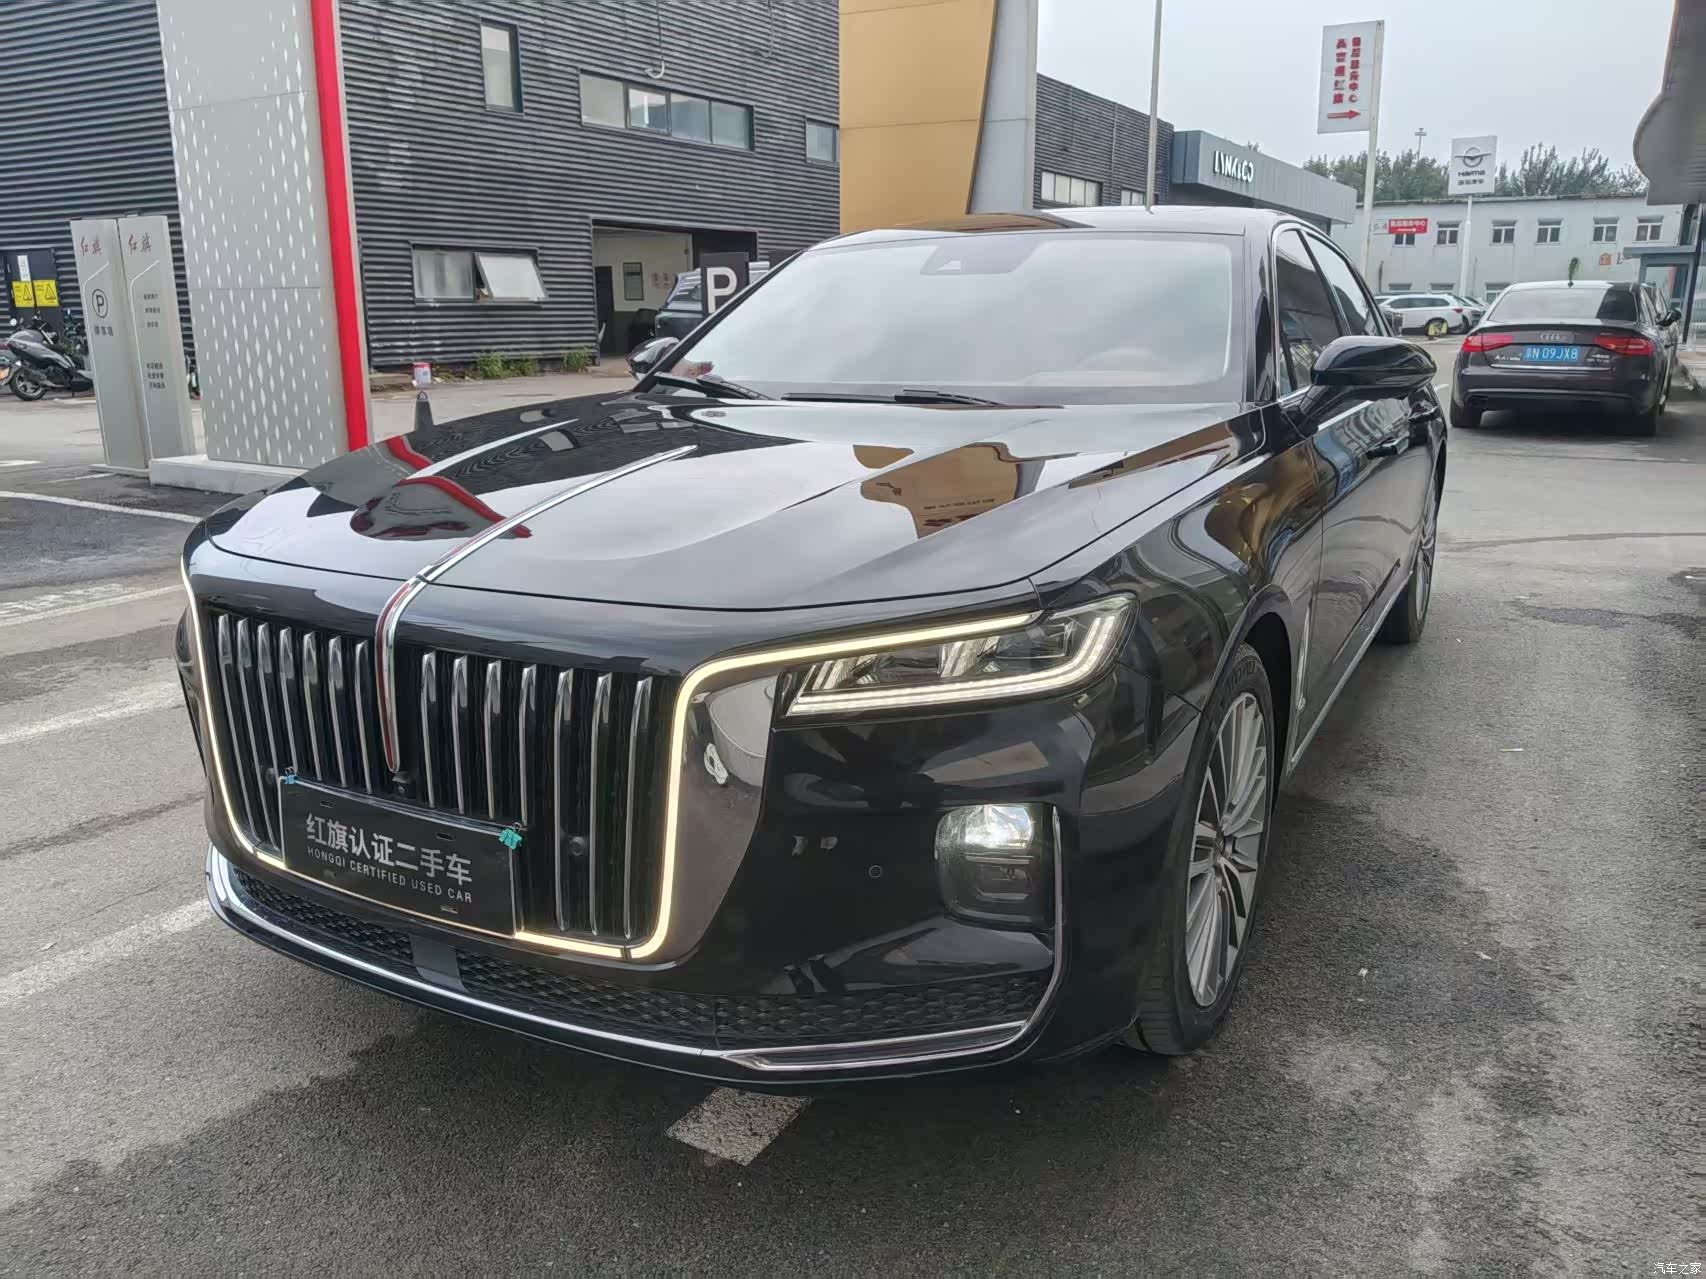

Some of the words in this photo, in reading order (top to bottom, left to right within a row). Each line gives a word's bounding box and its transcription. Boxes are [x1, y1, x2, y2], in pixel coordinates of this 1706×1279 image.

[705, 266, 739, 314] P
[306, 813, 473, 887] 红旗认证二手车
[307, 845, 346, 868] HONGQI
[350, 860, 406, 886] CERTIFIED
[411, 878, 442, 896] USED
[447, 887, 472, 905] CAR
